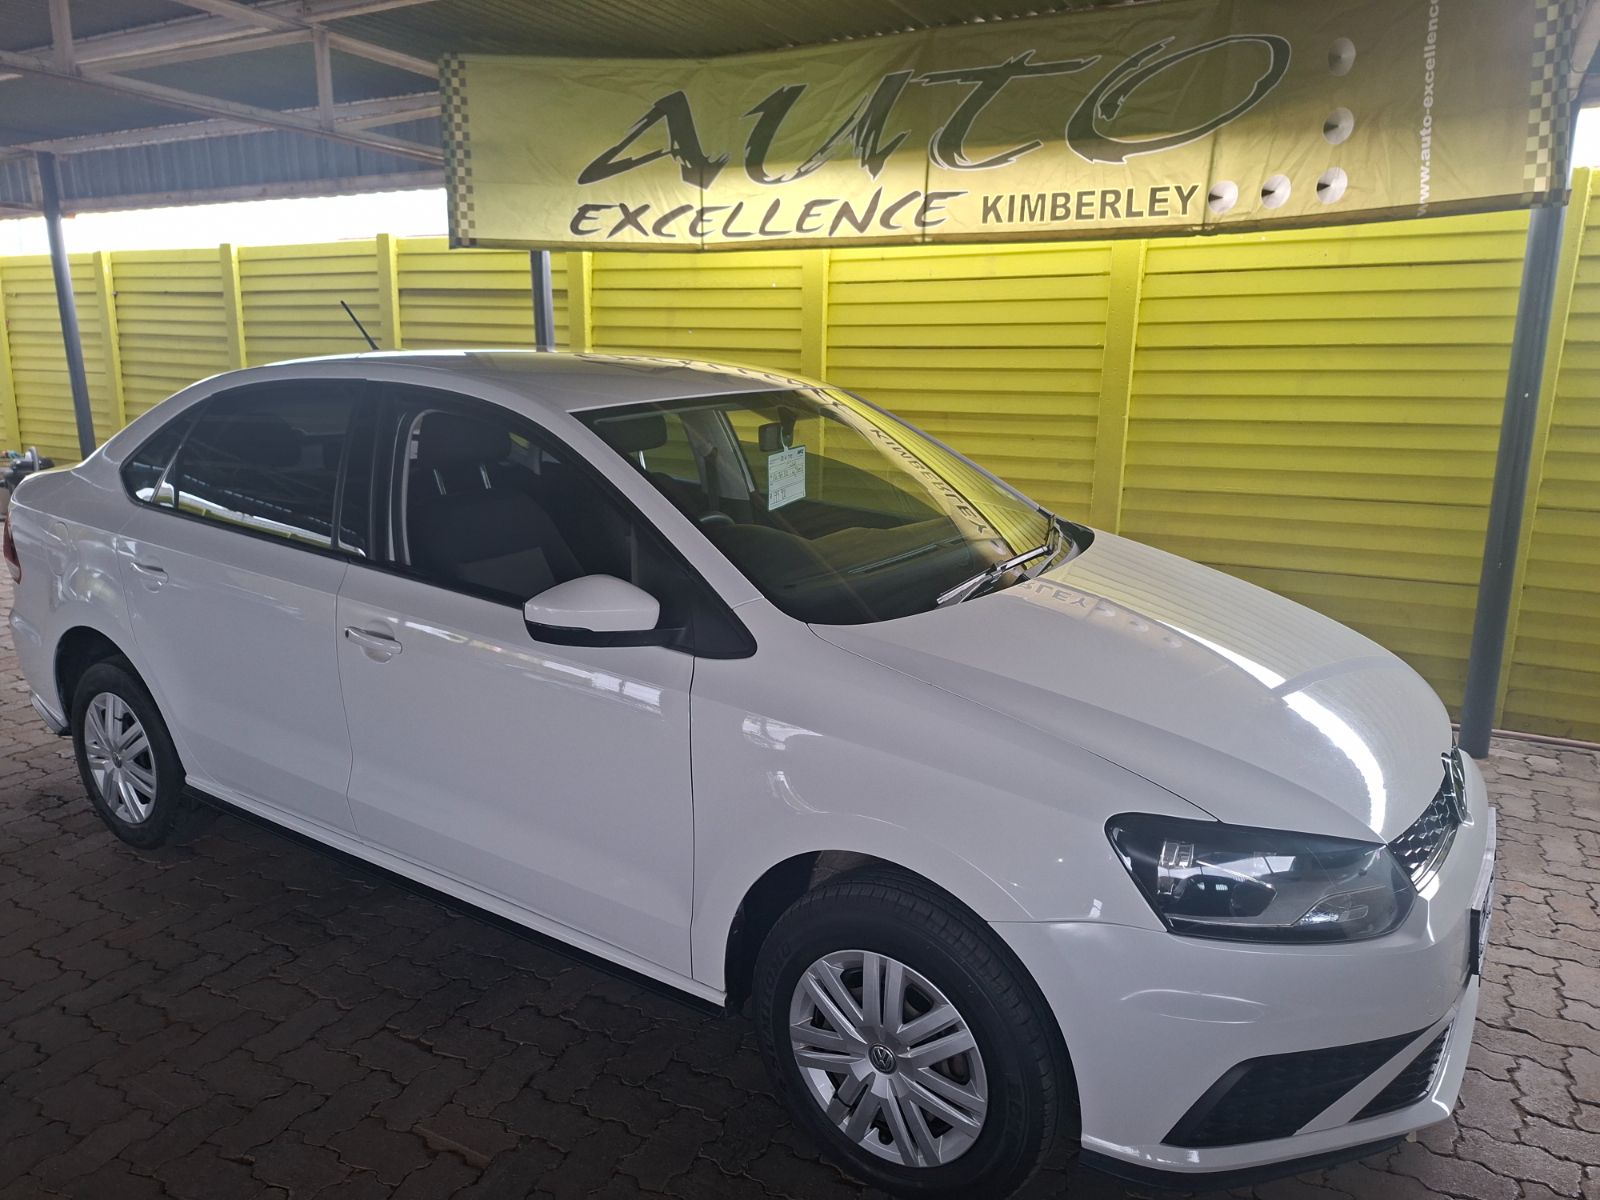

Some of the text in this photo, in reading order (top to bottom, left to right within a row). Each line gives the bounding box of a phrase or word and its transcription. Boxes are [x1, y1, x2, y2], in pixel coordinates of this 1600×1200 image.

[576, 33, 1293, 190] AUTO
[1416, 0, 1440, 218] www.auto-excellenc
[569, 186, 969, 239] EXCELLENCE
[981, 184, 1200, 225] KIMBERLEY
